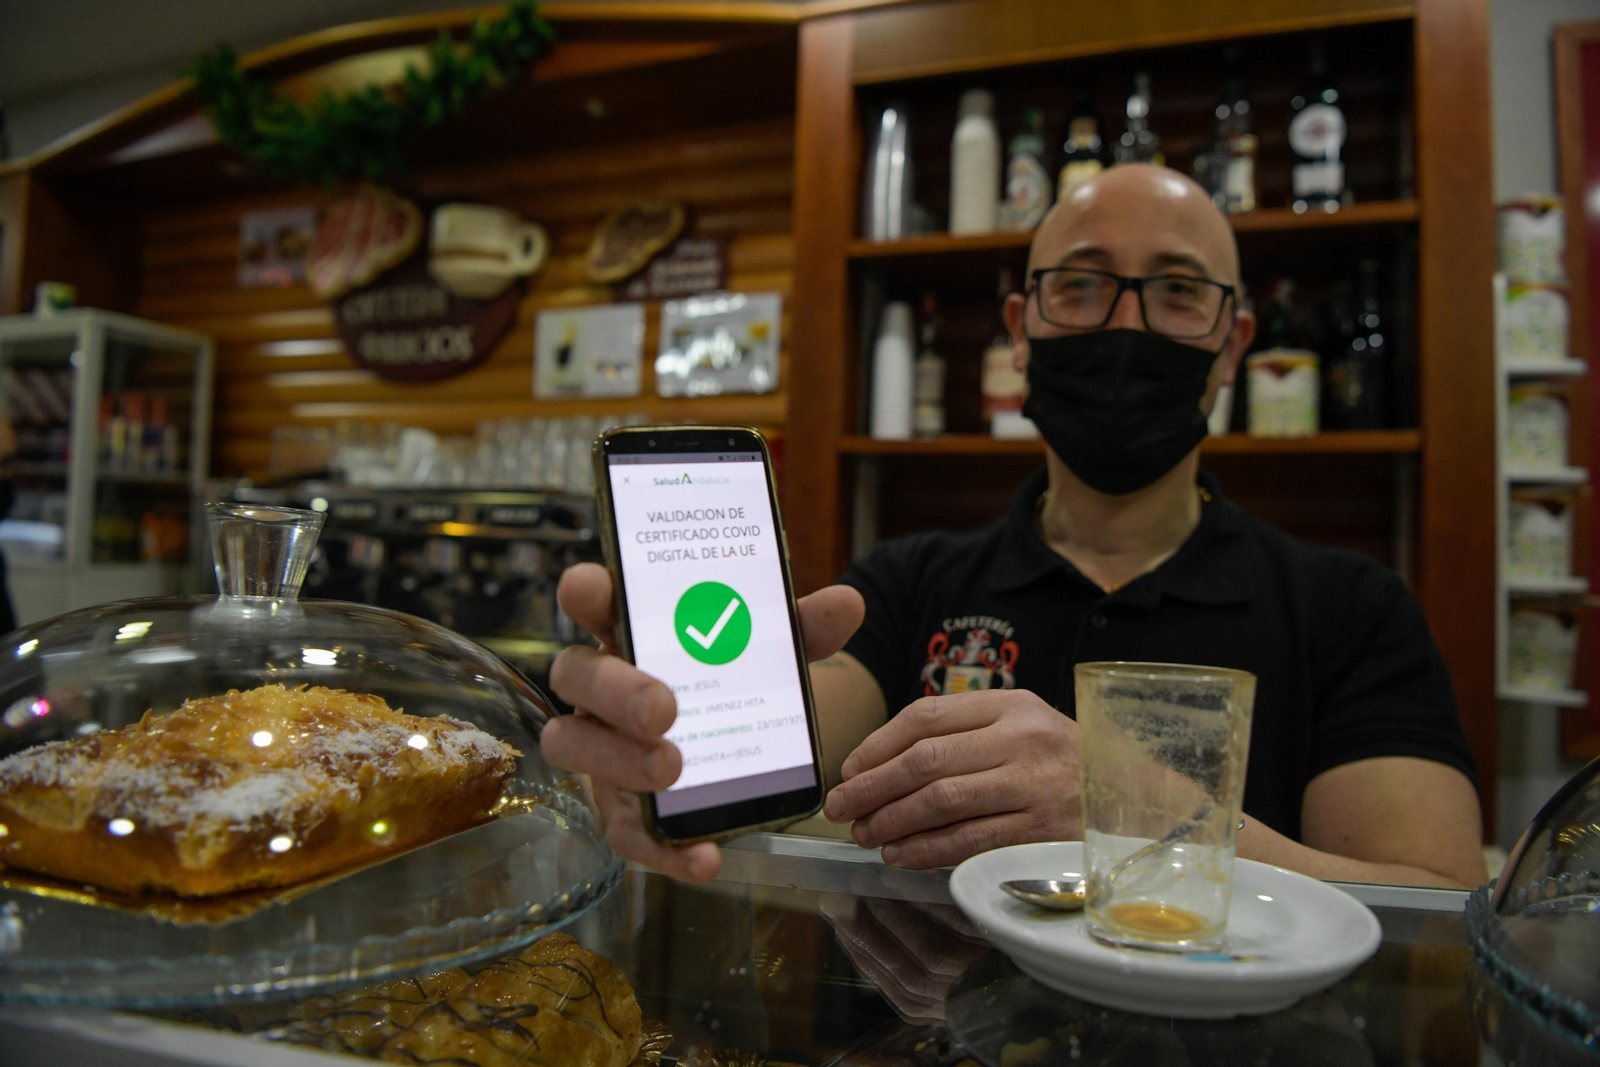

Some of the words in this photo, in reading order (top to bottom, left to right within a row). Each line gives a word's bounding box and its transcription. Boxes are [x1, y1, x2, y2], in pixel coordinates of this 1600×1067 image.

[653, 476, 680, 486] Salud
[646, 509, 725, 522] VALIDACION
[728, 507, 745, 519] DE
[635, 527, 719, 544] CERTIFICADO
[722, 525, 761, 538] COVID
[647, 549, 699, 563] DIGITAL
[701, 547, 718, 559] DE
[721, 546, 737, 558] LA
[740, 544, 756, 556] UE
[694, 679, 721, 692] JESUS
[704, 699, 743, 714] JIMENEZ
[743, 697, 766, 708] HITA
[687, 731, 699, 742] de
[757, 713, 805, 731] 23/10/1975
